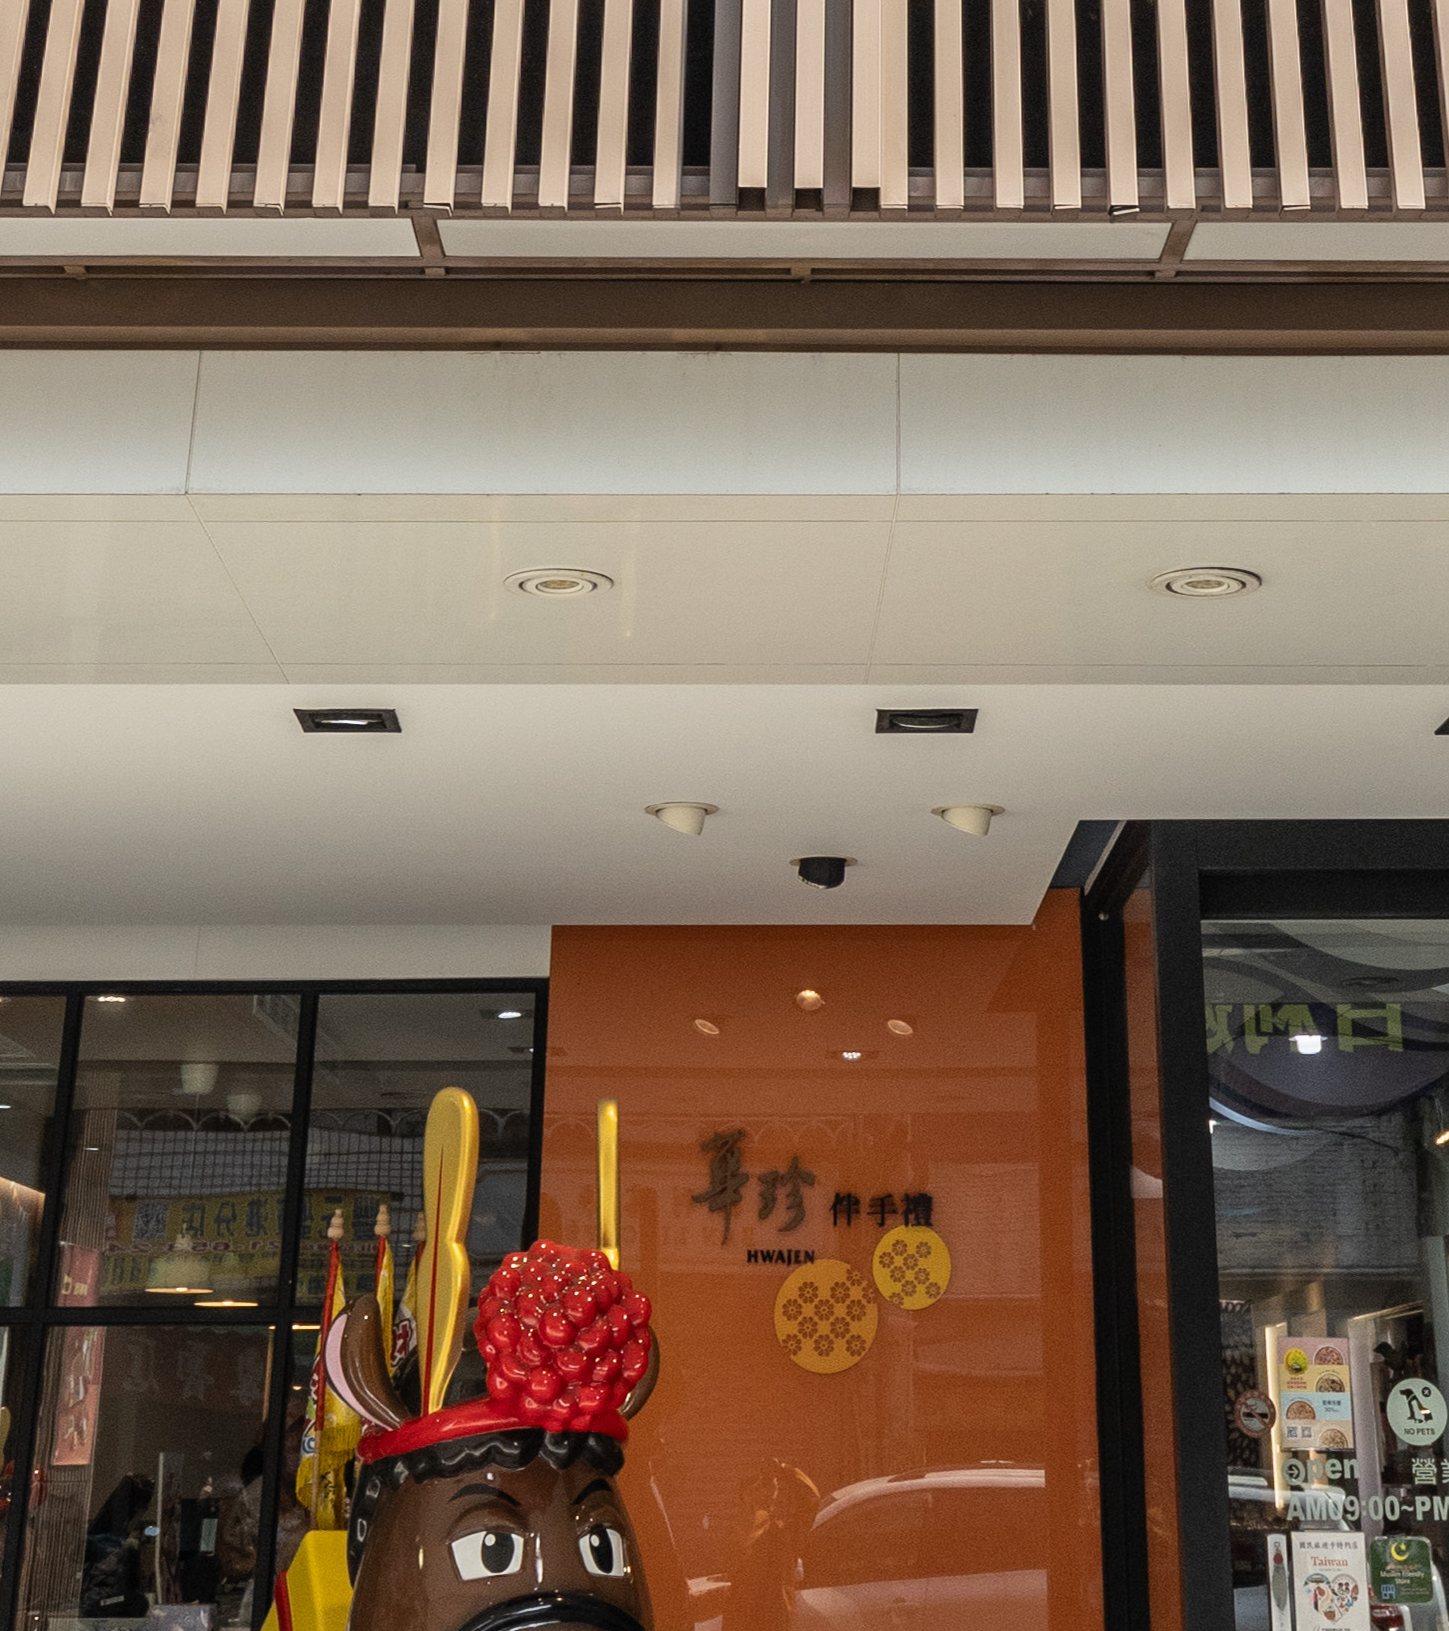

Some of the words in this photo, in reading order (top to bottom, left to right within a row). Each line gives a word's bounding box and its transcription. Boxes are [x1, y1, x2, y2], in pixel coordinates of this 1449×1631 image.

[829, 1192, 933, 1228] 伴手禮
[746, 1249, 815, 1266] HWAJEN
[1404, 1428, 1416, 1436] NO
[1417, 1428, 1435, 1436] PETS
[1310, 1556, 1348, 1567] Taiwan
